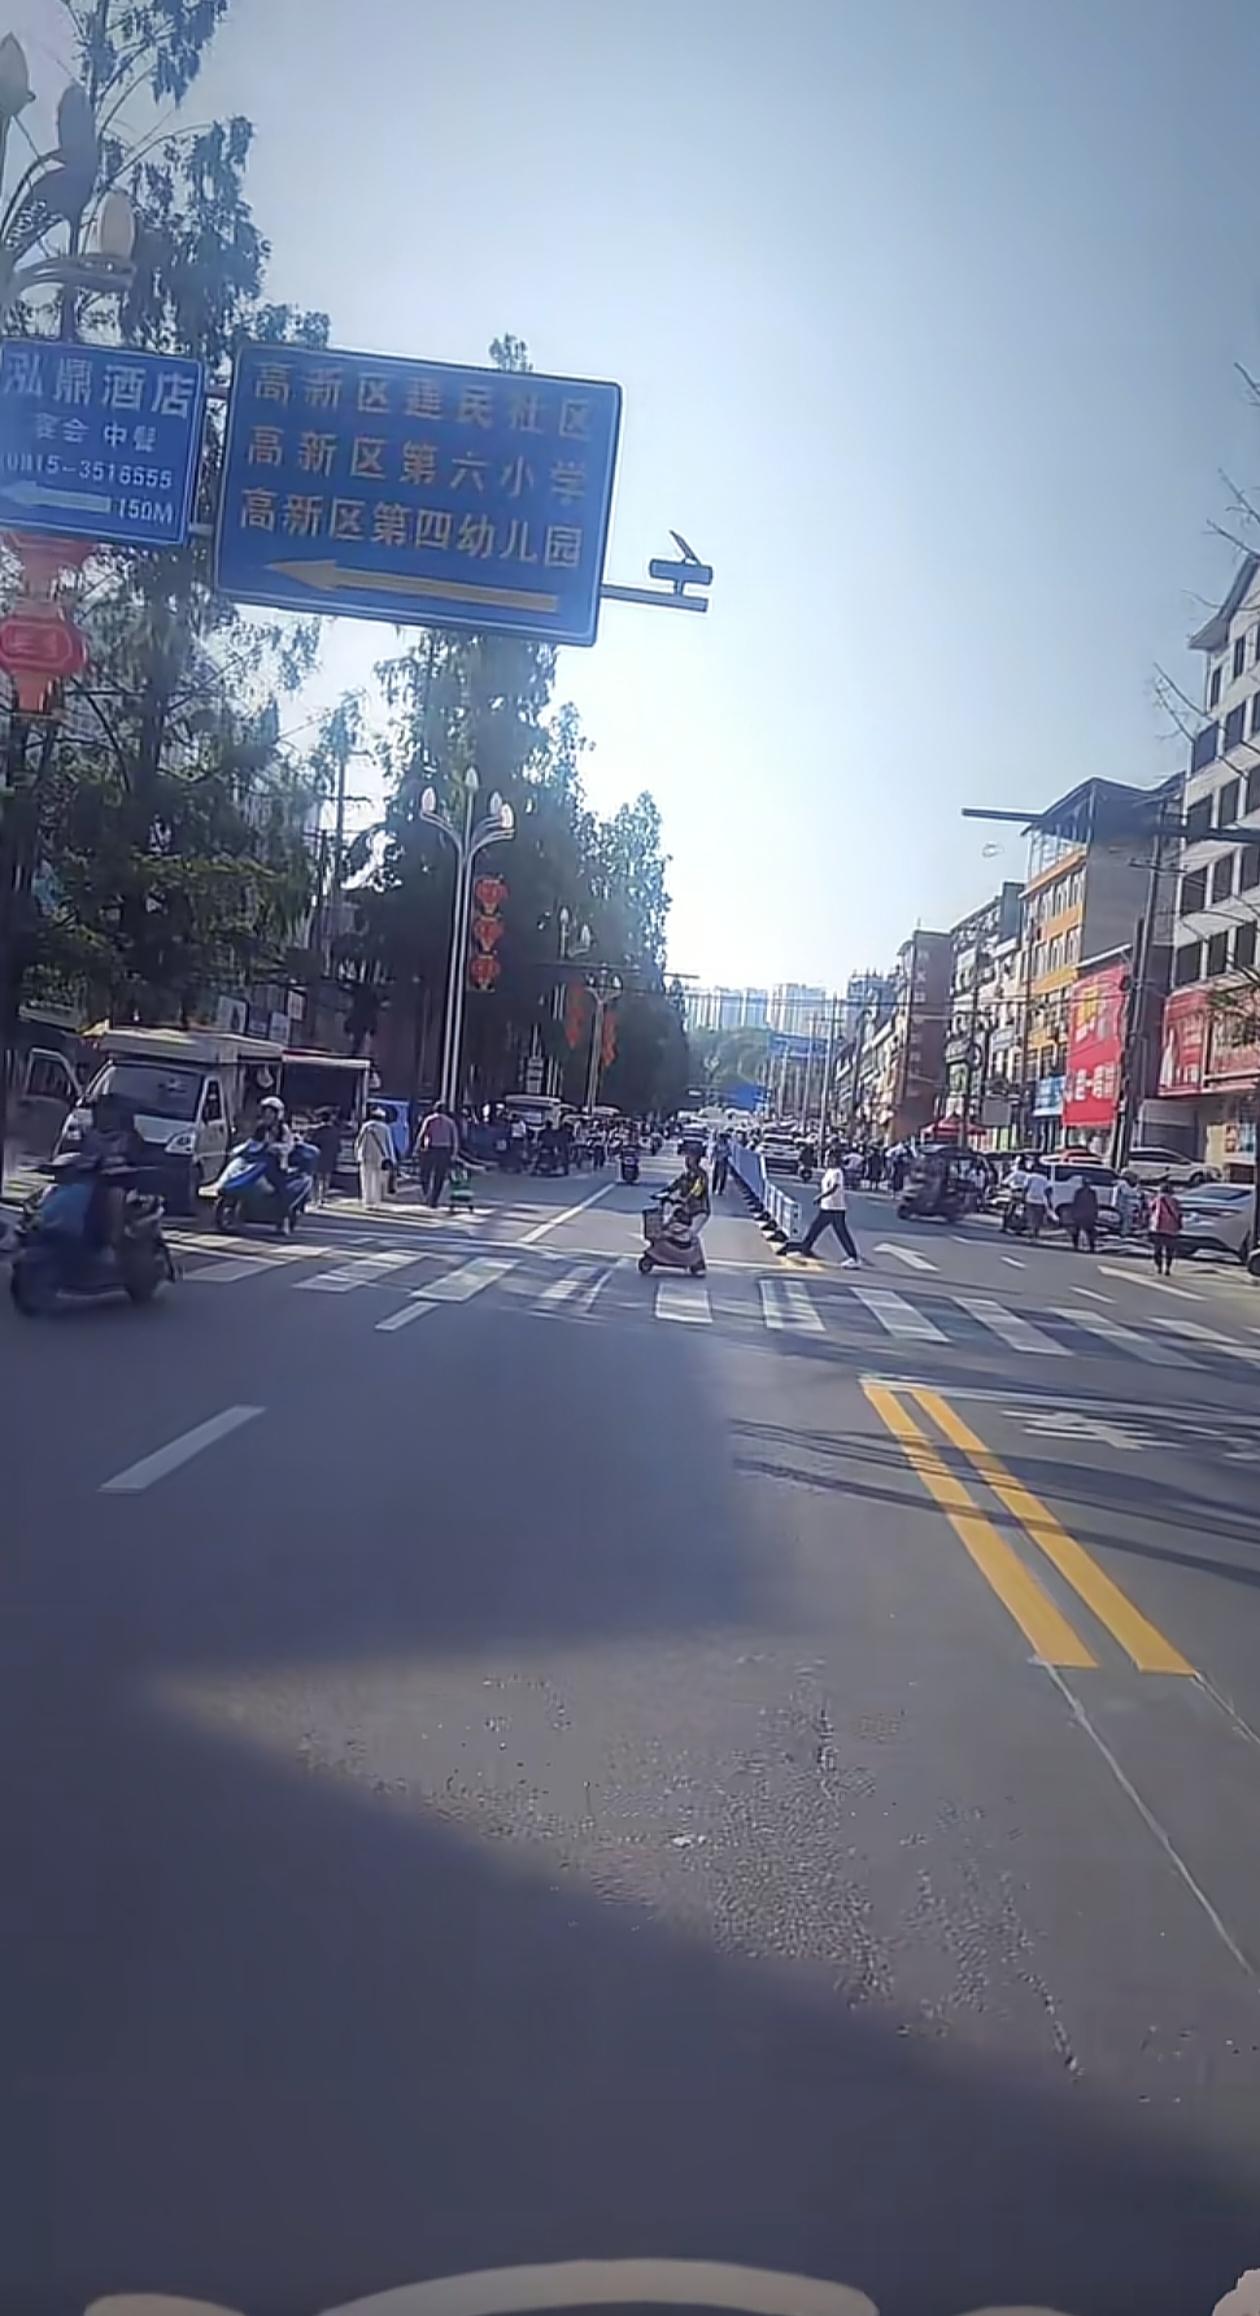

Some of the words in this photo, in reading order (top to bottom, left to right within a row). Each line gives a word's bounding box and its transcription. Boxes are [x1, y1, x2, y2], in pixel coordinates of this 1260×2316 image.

[4, 352, 194, 418] 泓鼎酒店
[254, 360, 592, 443] 高新区建民社区
[248, 424, 586, 505] 高新区第六小学
[119, 498, 173, 524] 150M
[240, 486, 582, 569] 高新区第四幼儿园
